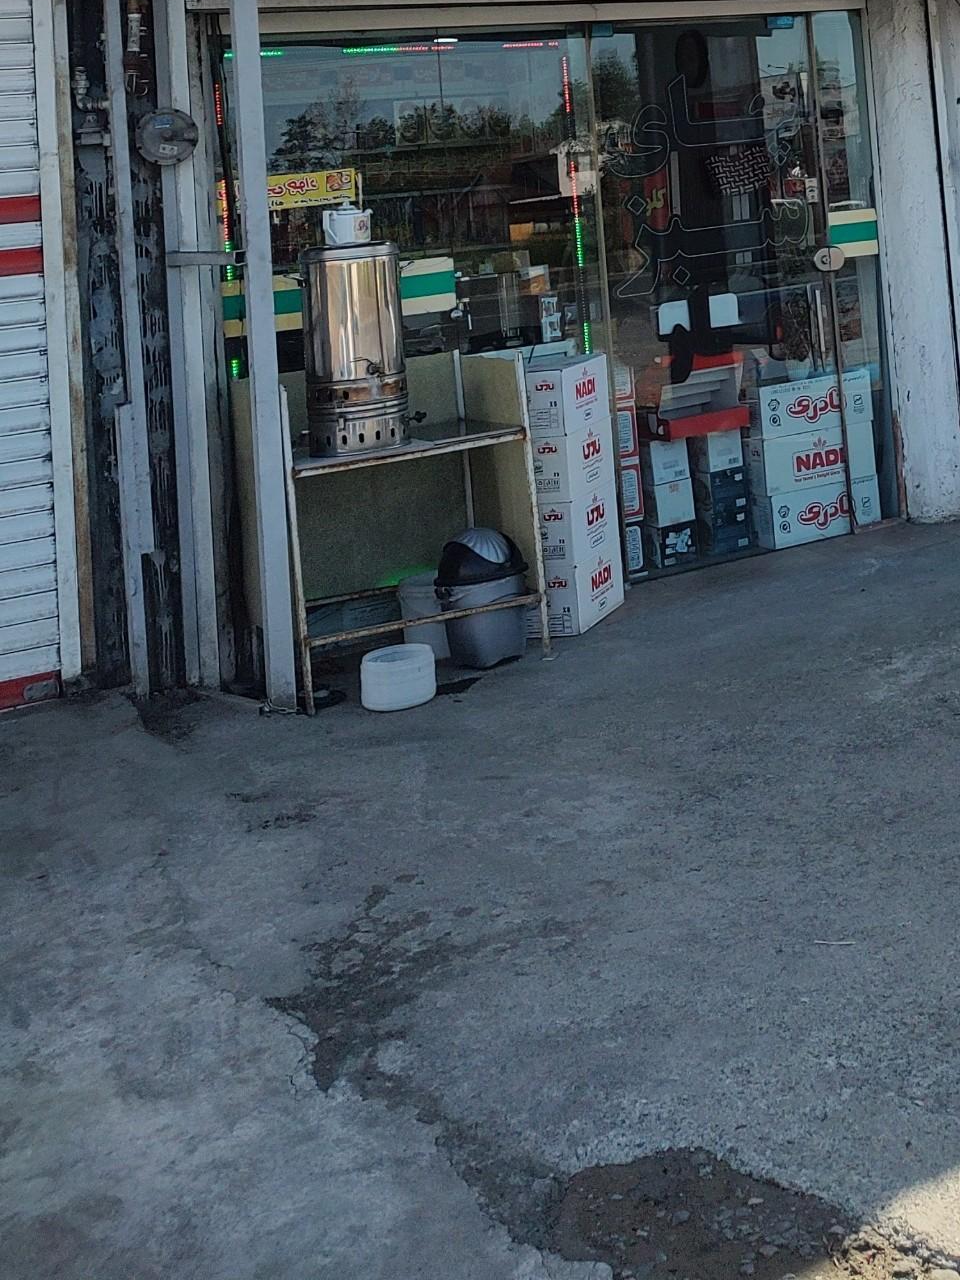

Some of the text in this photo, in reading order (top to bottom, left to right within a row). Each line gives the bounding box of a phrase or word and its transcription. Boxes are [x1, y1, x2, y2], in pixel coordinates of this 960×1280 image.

[575, 377, 596, 401] NADI
[788, 387, 847, 423] ادری
[797, 491, 856, 530] ادری
[591, 564, 612, 593] NADI
